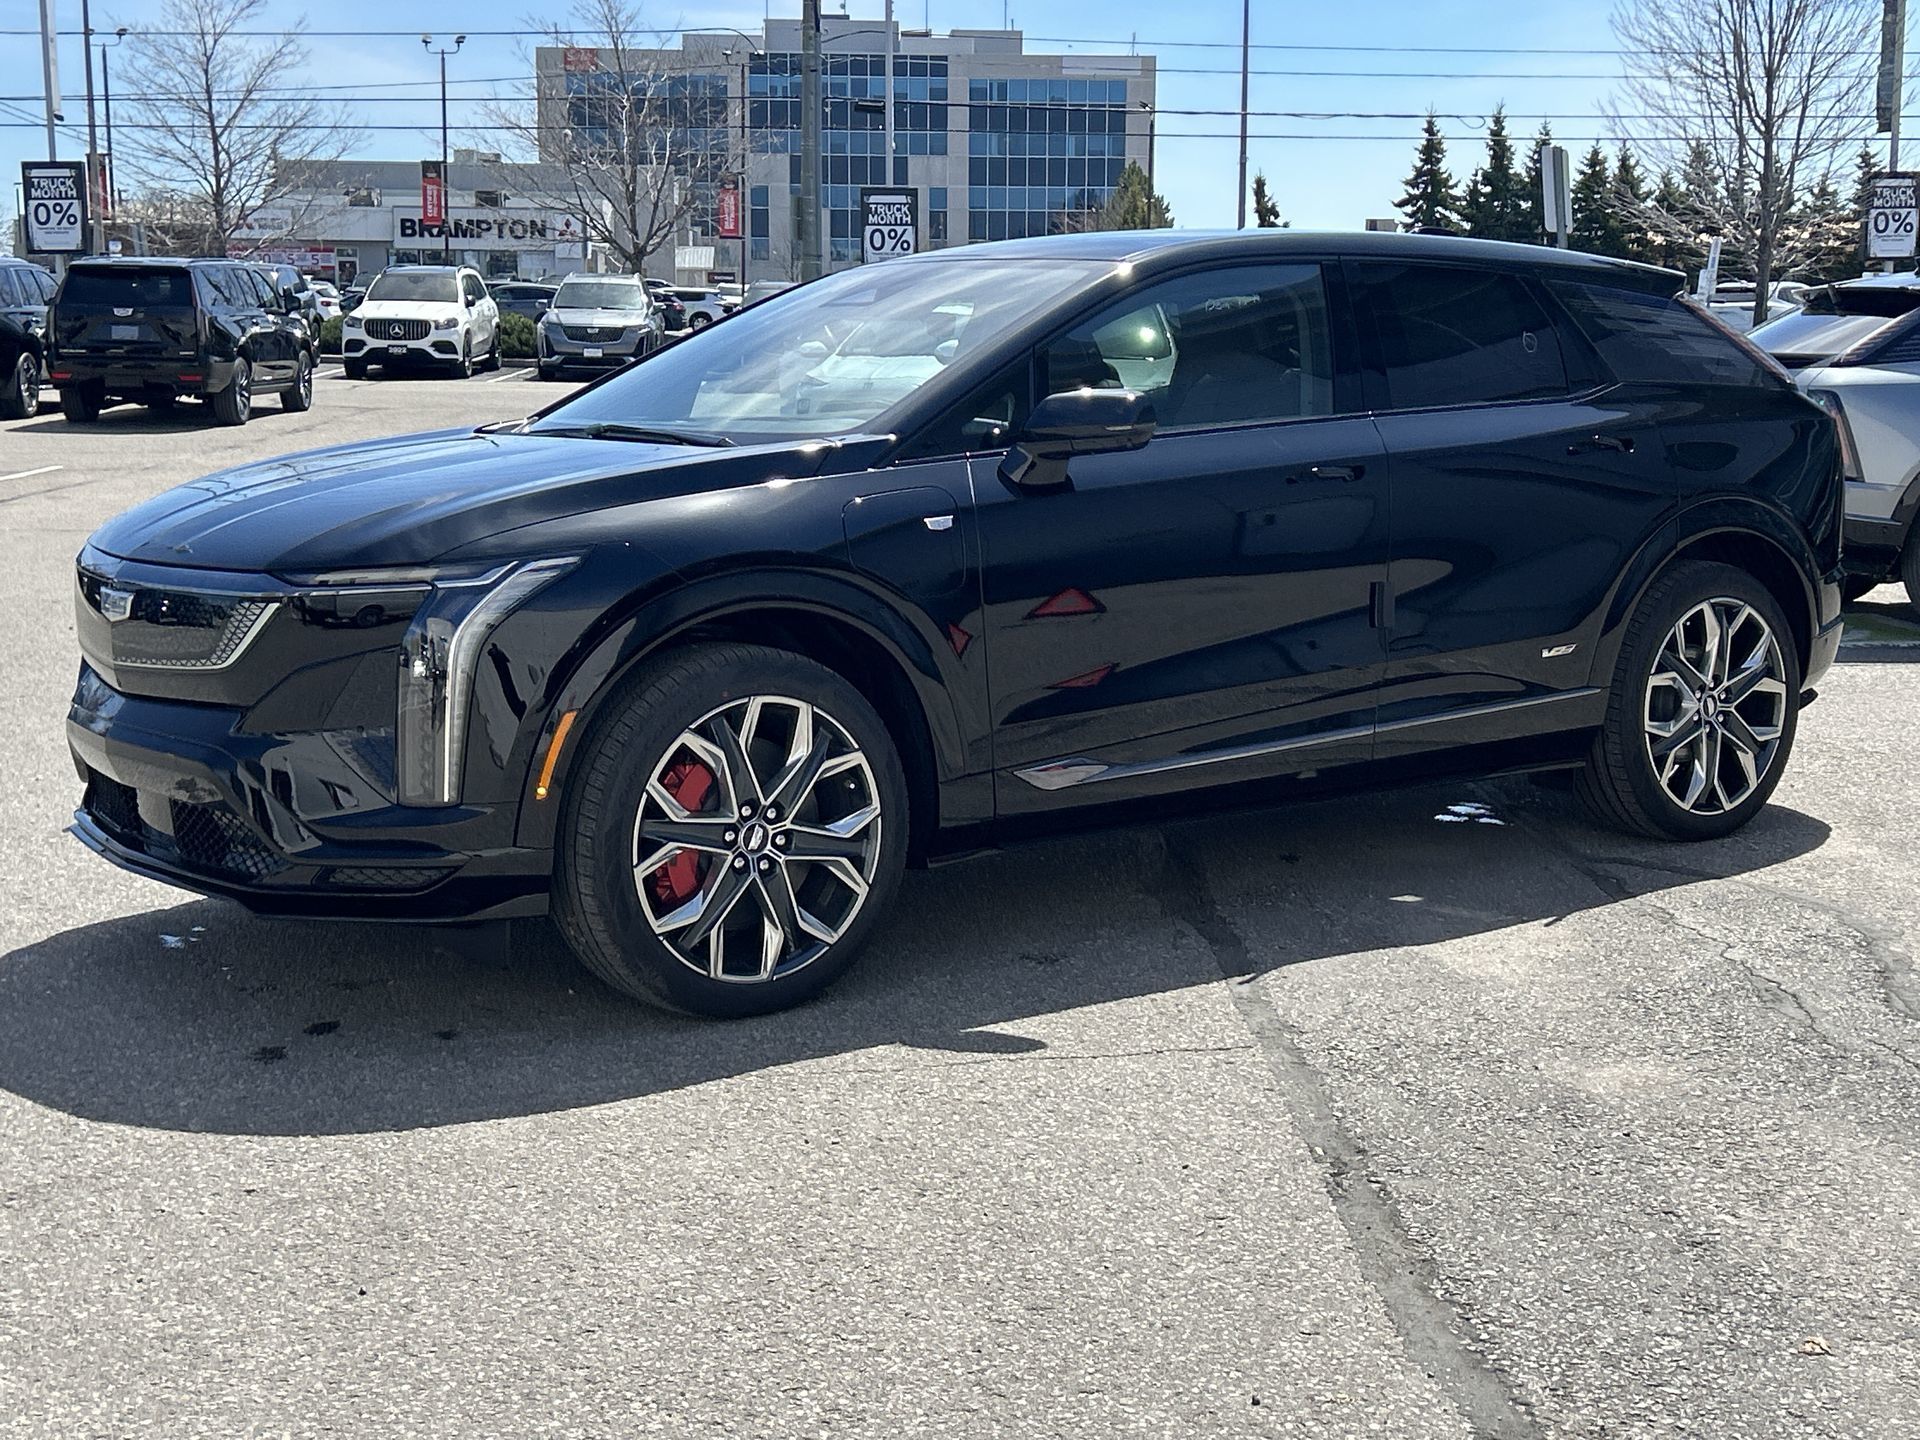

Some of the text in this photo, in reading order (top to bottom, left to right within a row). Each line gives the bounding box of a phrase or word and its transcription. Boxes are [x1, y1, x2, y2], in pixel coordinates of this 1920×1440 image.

[31, 178, 75, 189] TRUCK
[31, 187, 77, 199] MONTH
[1874, 187, 1915, 197] TRUCK
[1873, 196, 1916, 207] MONTH
[34, 202, 78, 226] 0%
[869, 204, 910, 215] TRUCK
[868, 213, 911, 224] MONTH
[1873, 210, 1914, 234] 0%
[400, 218, 547, 239] BRAMPTON
[869, 228, 911, 252] 0%
[311, 253, 320, 265] 5
